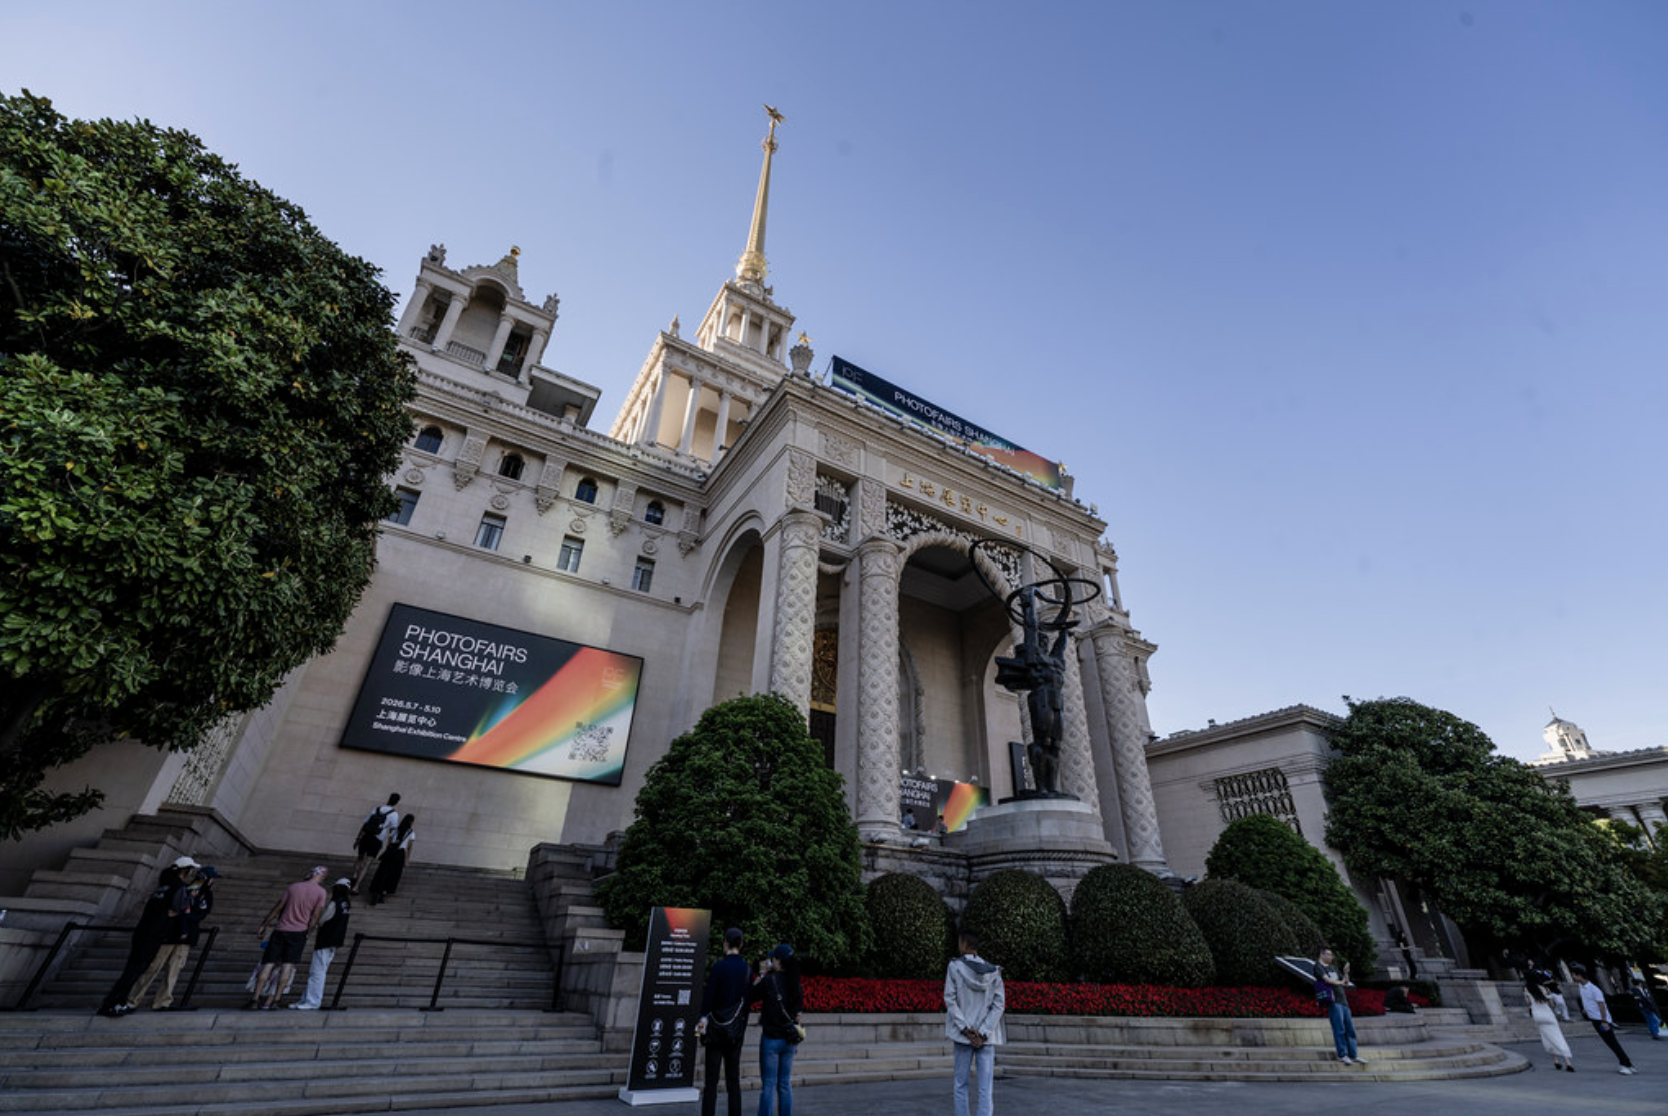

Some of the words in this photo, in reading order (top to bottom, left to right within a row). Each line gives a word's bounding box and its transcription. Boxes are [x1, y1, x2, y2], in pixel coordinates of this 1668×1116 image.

[894, 391, 962, 431] PHOTOFAIRS
[399, 641, 504, 676] SHANGHAI
[404, 624, 528, 664] PHOTOFAIRS
[393, 659, 519, 695] 影像上海艺术博览会
[376, 709, 437, 727] 上海展览中心
[424, 705, 441, 714] 5.10
[372, 721, 406, 733] Shanghai
[407, 727, 442, 739] Exhibition
